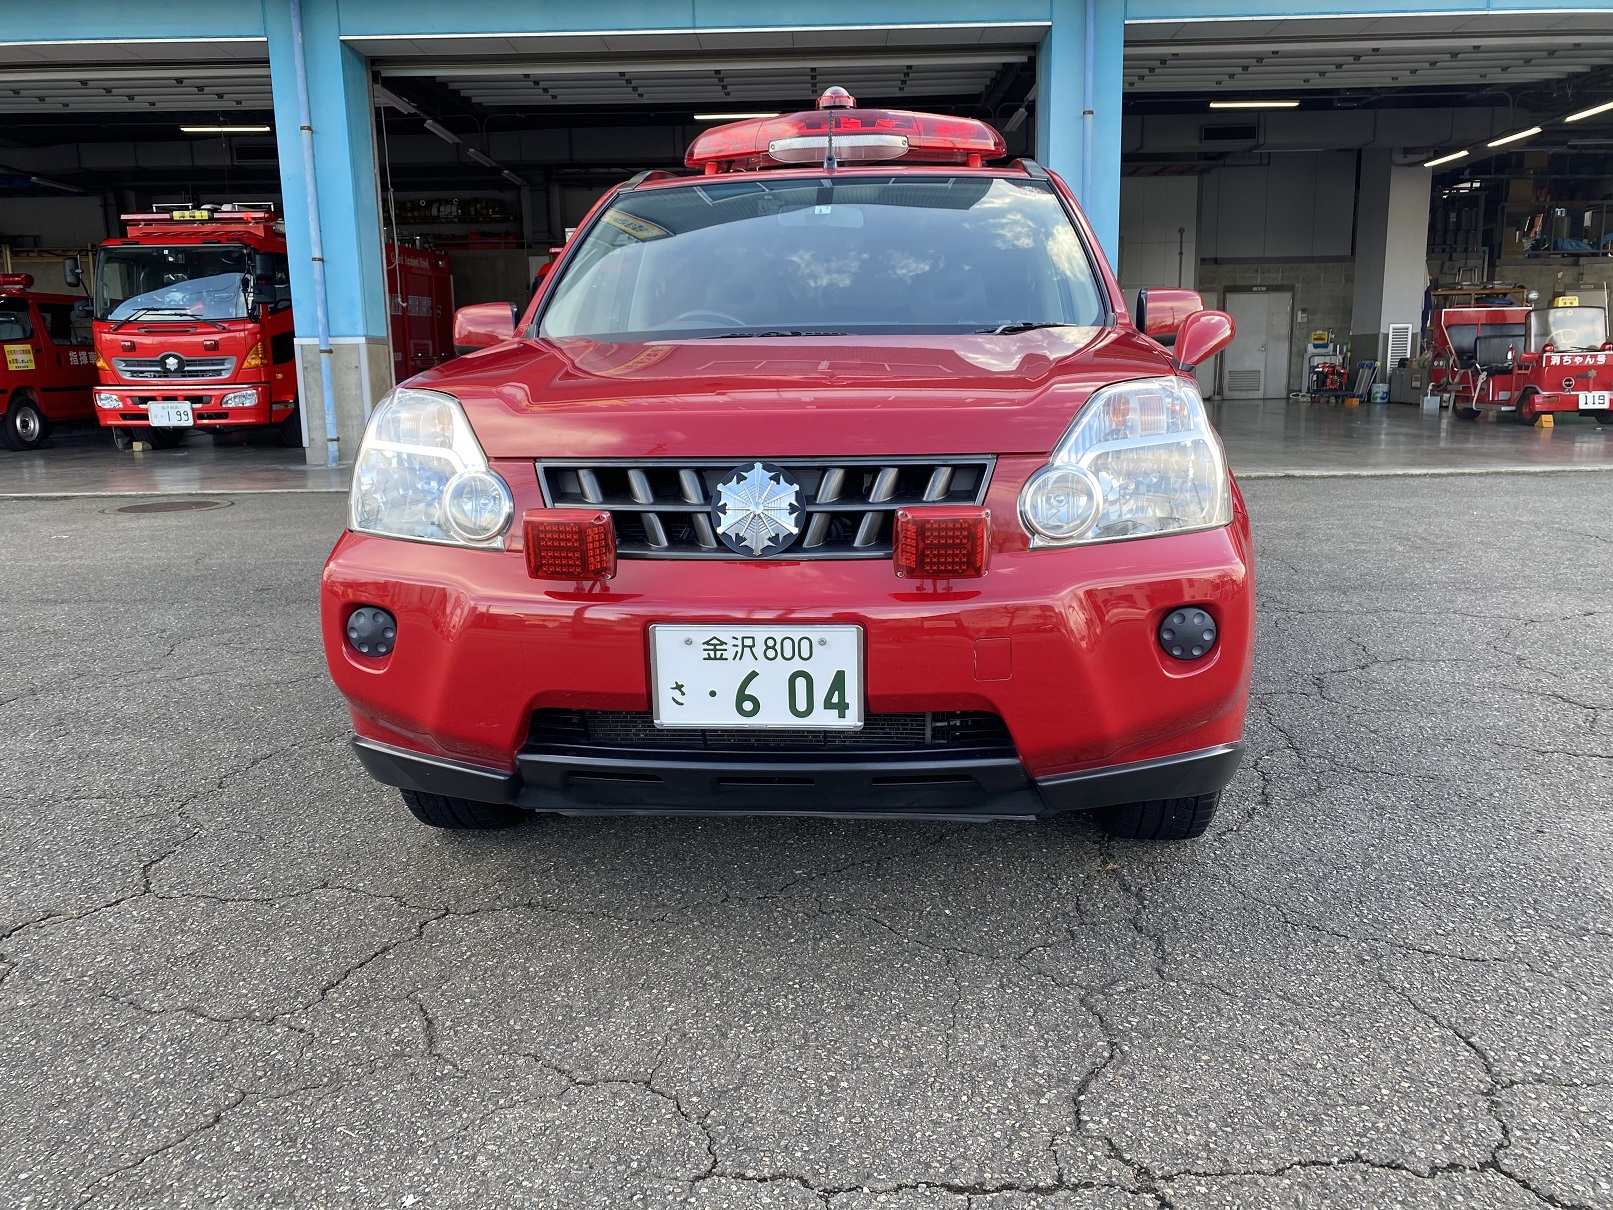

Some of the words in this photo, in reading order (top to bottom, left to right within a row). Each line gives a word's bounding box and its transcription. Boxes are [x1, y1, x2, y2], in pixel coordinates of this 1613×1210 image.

[1550, 354, 1607, 366] 消ちゃん号
[1584, 394, 1606, 405] 119
